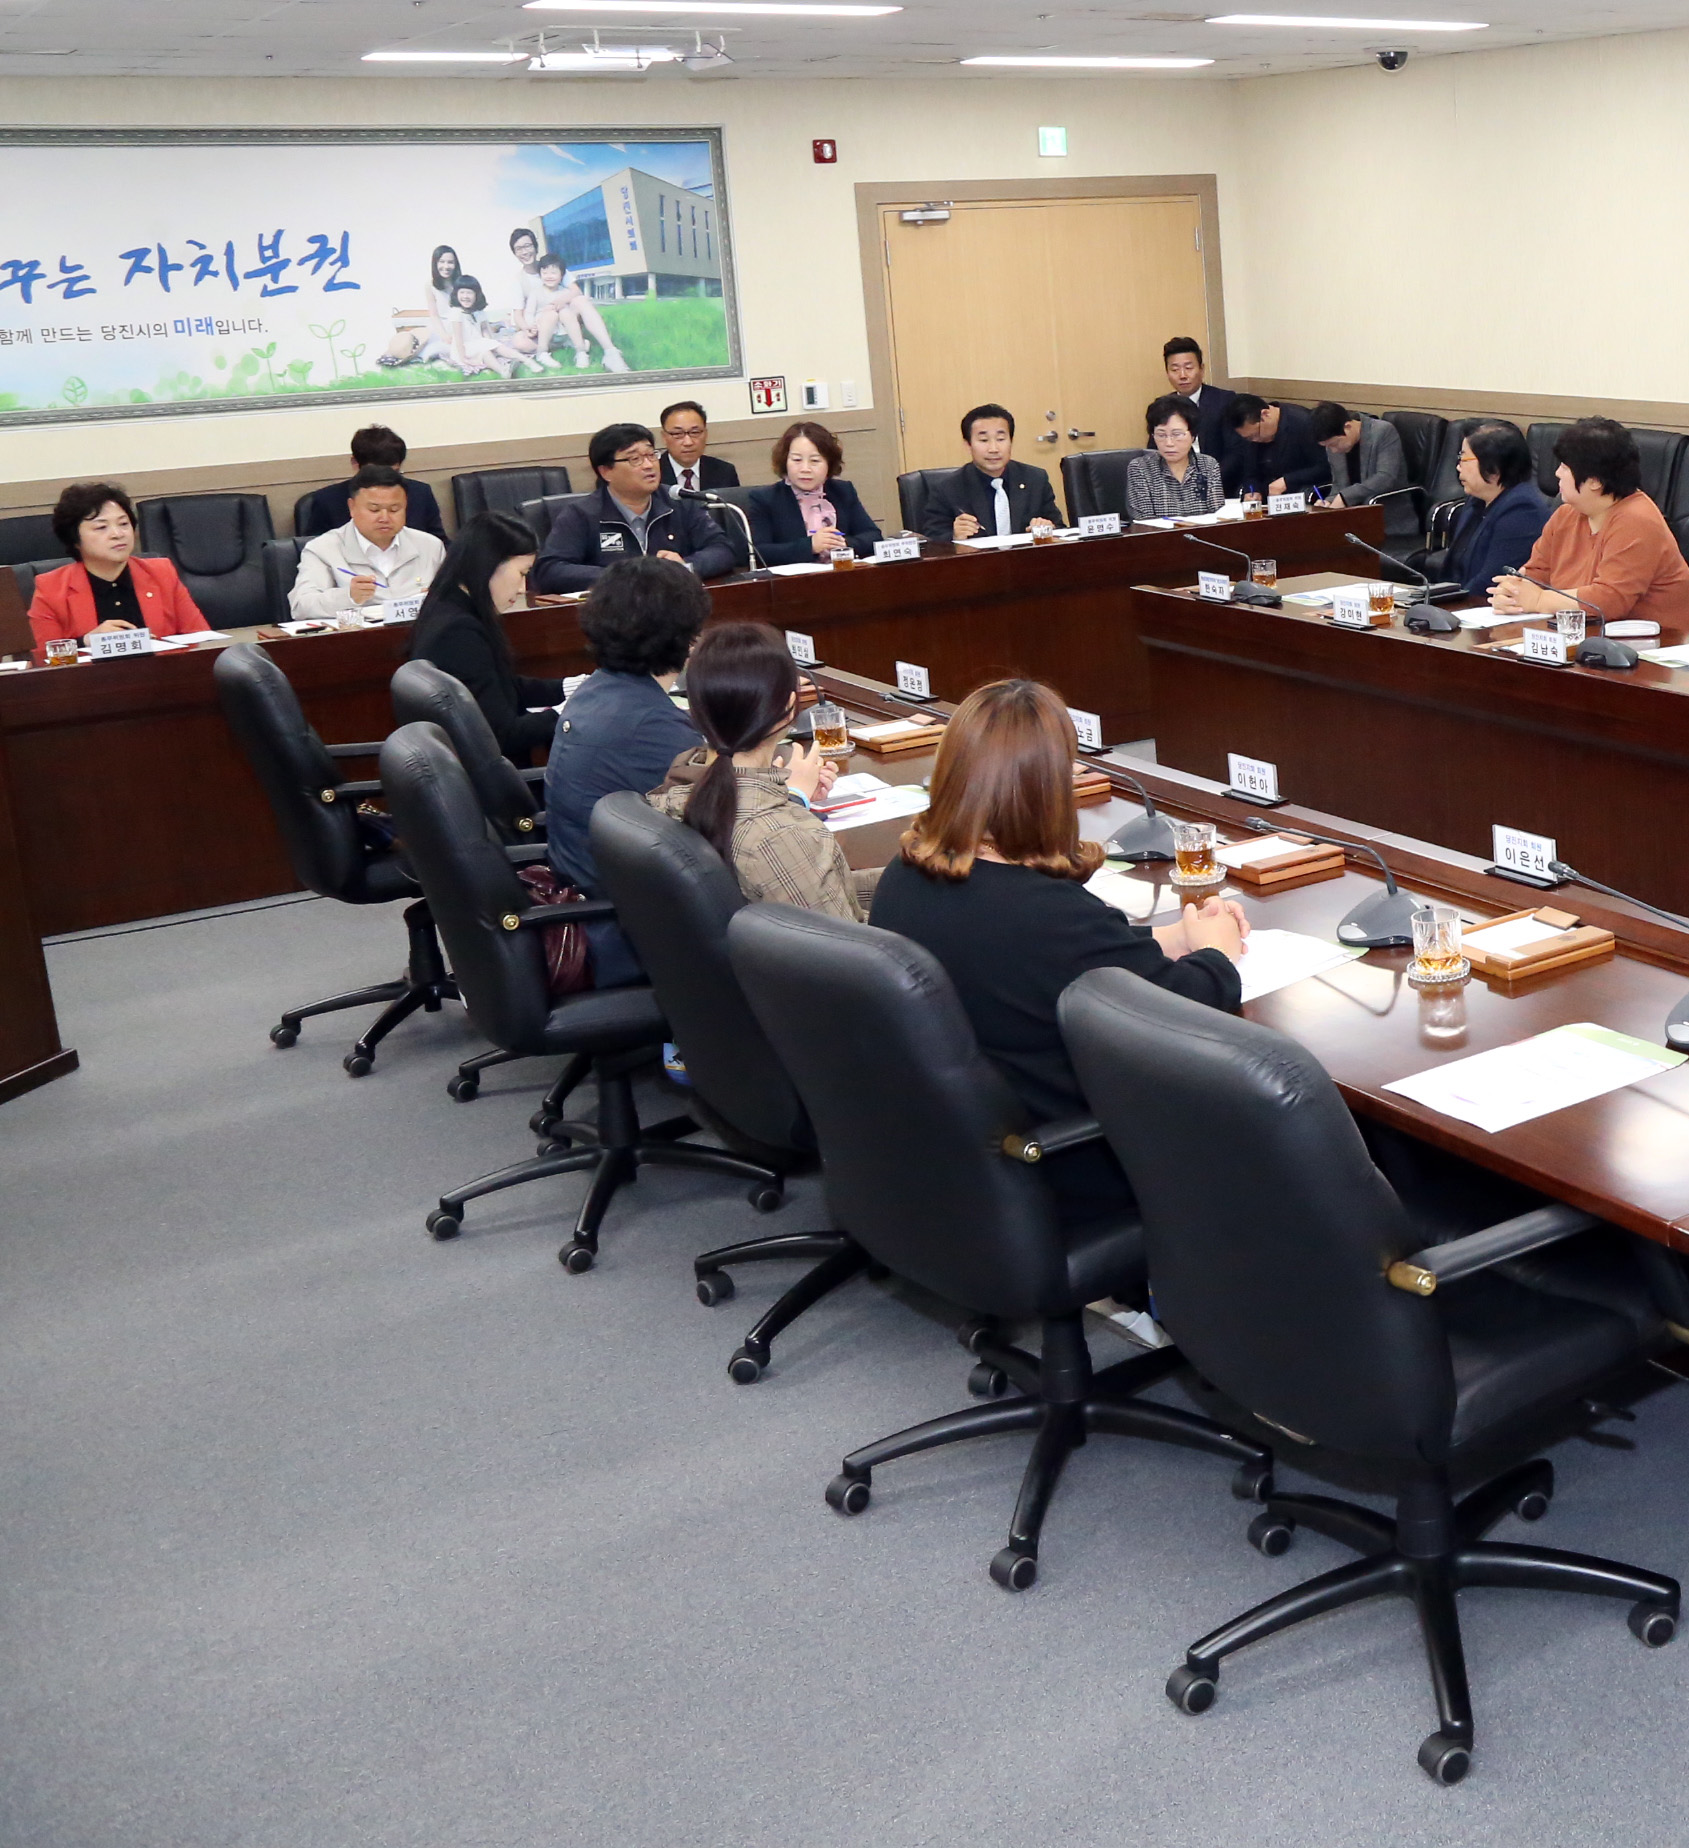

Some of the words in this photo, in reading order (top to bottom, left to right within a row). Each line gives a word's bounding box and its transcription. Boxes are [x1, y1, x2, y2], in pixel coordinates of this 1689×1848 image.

[119, 229, 361, 298] 자치분권
[0, 328, 33, 345] 함께
[41, 326, 93, 344] 만드는
[100, 322, 169, 342] 당진시의
[173, 316, 269, 337] 미래입니다.
[753, 379, 782, 390] 소화기
[1088, 523, 1114, 533] 윤명수
[883, 547, 912, 558] 최연숙
[395, 607, 418, 618] 서영
[1531, 642, 1558, 657] 김남숙
[1077, 726, 1093, 742] 노금
[1505, 834, 1528, 848] 당진지회
[1530, 842, 1542, 852] 회원
[1505, 847, 1544, 872] 이은선
